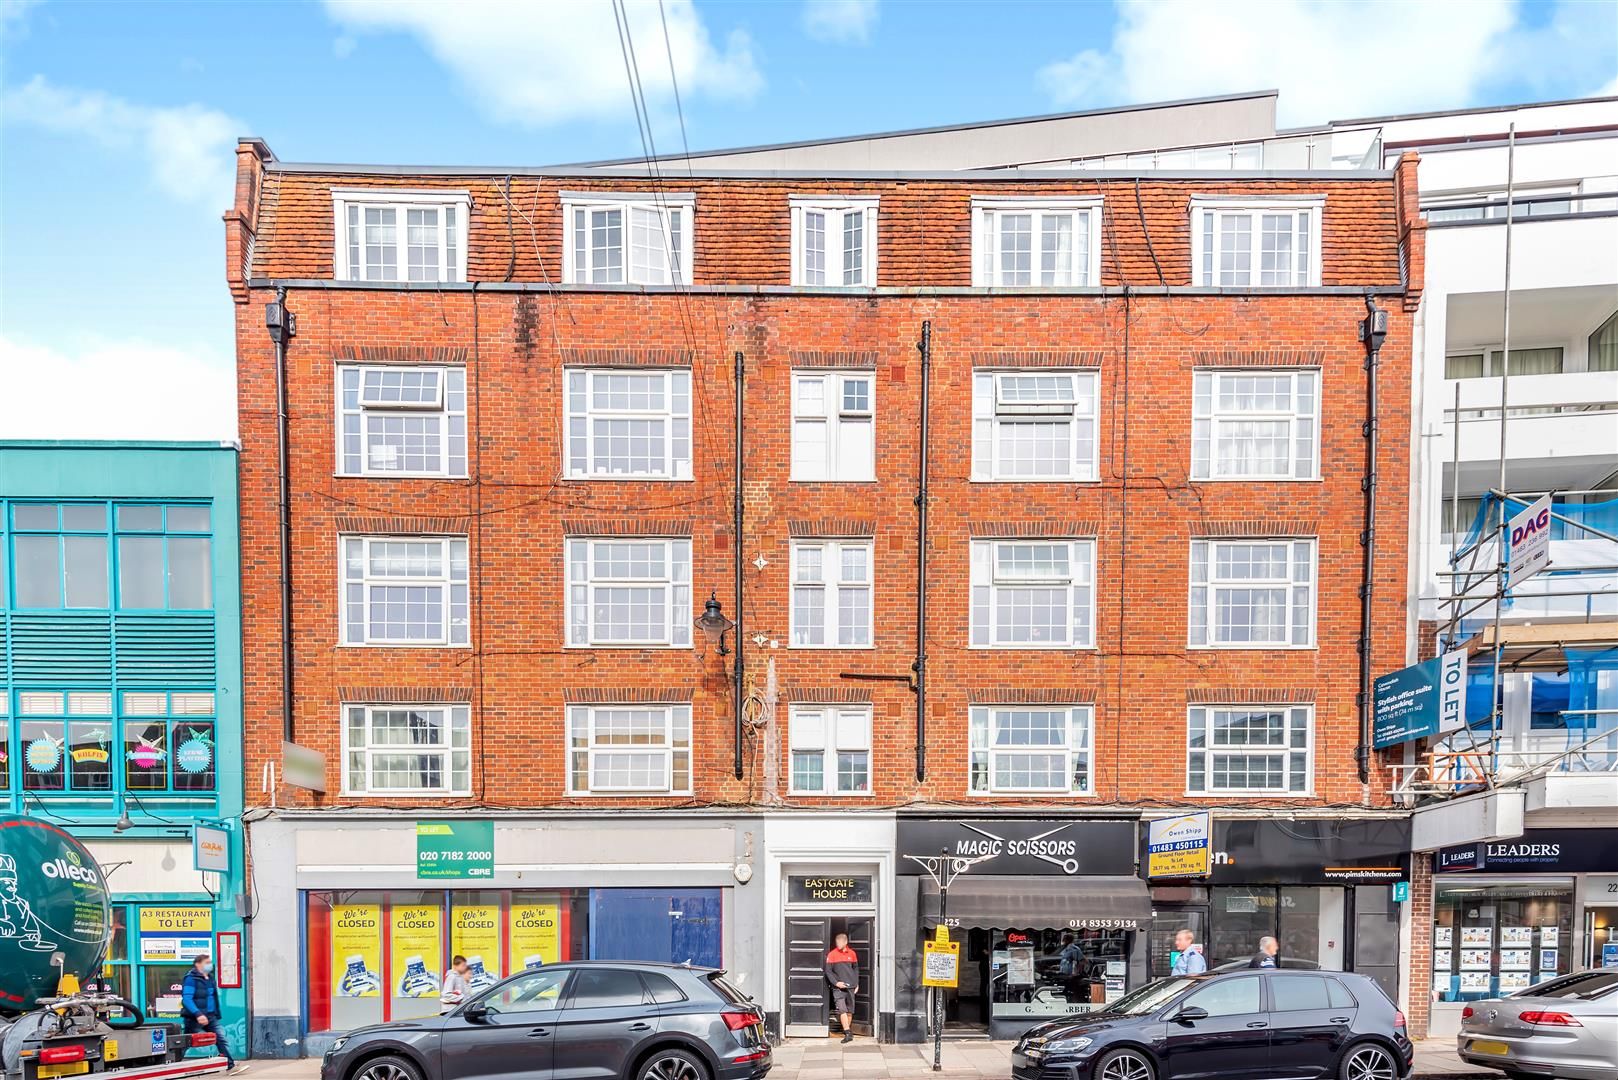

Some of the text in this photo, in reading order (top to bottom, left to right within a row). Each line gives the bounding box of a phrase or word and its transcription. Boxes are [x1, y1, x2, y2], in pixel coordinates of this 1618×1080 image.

[1512, 508, 1548, 547] DAG
[1444, 657, 1461, 722] TO LET
[1377, 685, 1433, 706] Stylish office suite
[1377, 699, 1414, 714] with parking
[956, 840, 1077, 855] MAGIC SCISSORS
[1152, 840, 1204, 853] 01483 450115
[1487, 844, 1560, 856] LEADERS
[420, 851, 492, 860] 020 7182 2000
[1450, 851, 1475, 861] LEADERS
[41, 858, 98, 884] olleco
[1325, 871, 1402, 879] www.pimskitchens.com
[805, 879, 854, 888] EASTGATE
[813, 889, 847, 899] HOUSE
[343, 909, 368, 919] We're
[403, 909, 428, 920] We're
[462, 909, 487, 920] We're
[521, 908, 546, 919] We're
[159, 919, 194, 928] TO LET
[337, 920, 375, 928] CLOSED
[515, 920, 553, 928] CLOSED
[1069, 919, 1137, 927] 014 8353 9134
[1008, 933, 1027, 942] Open
